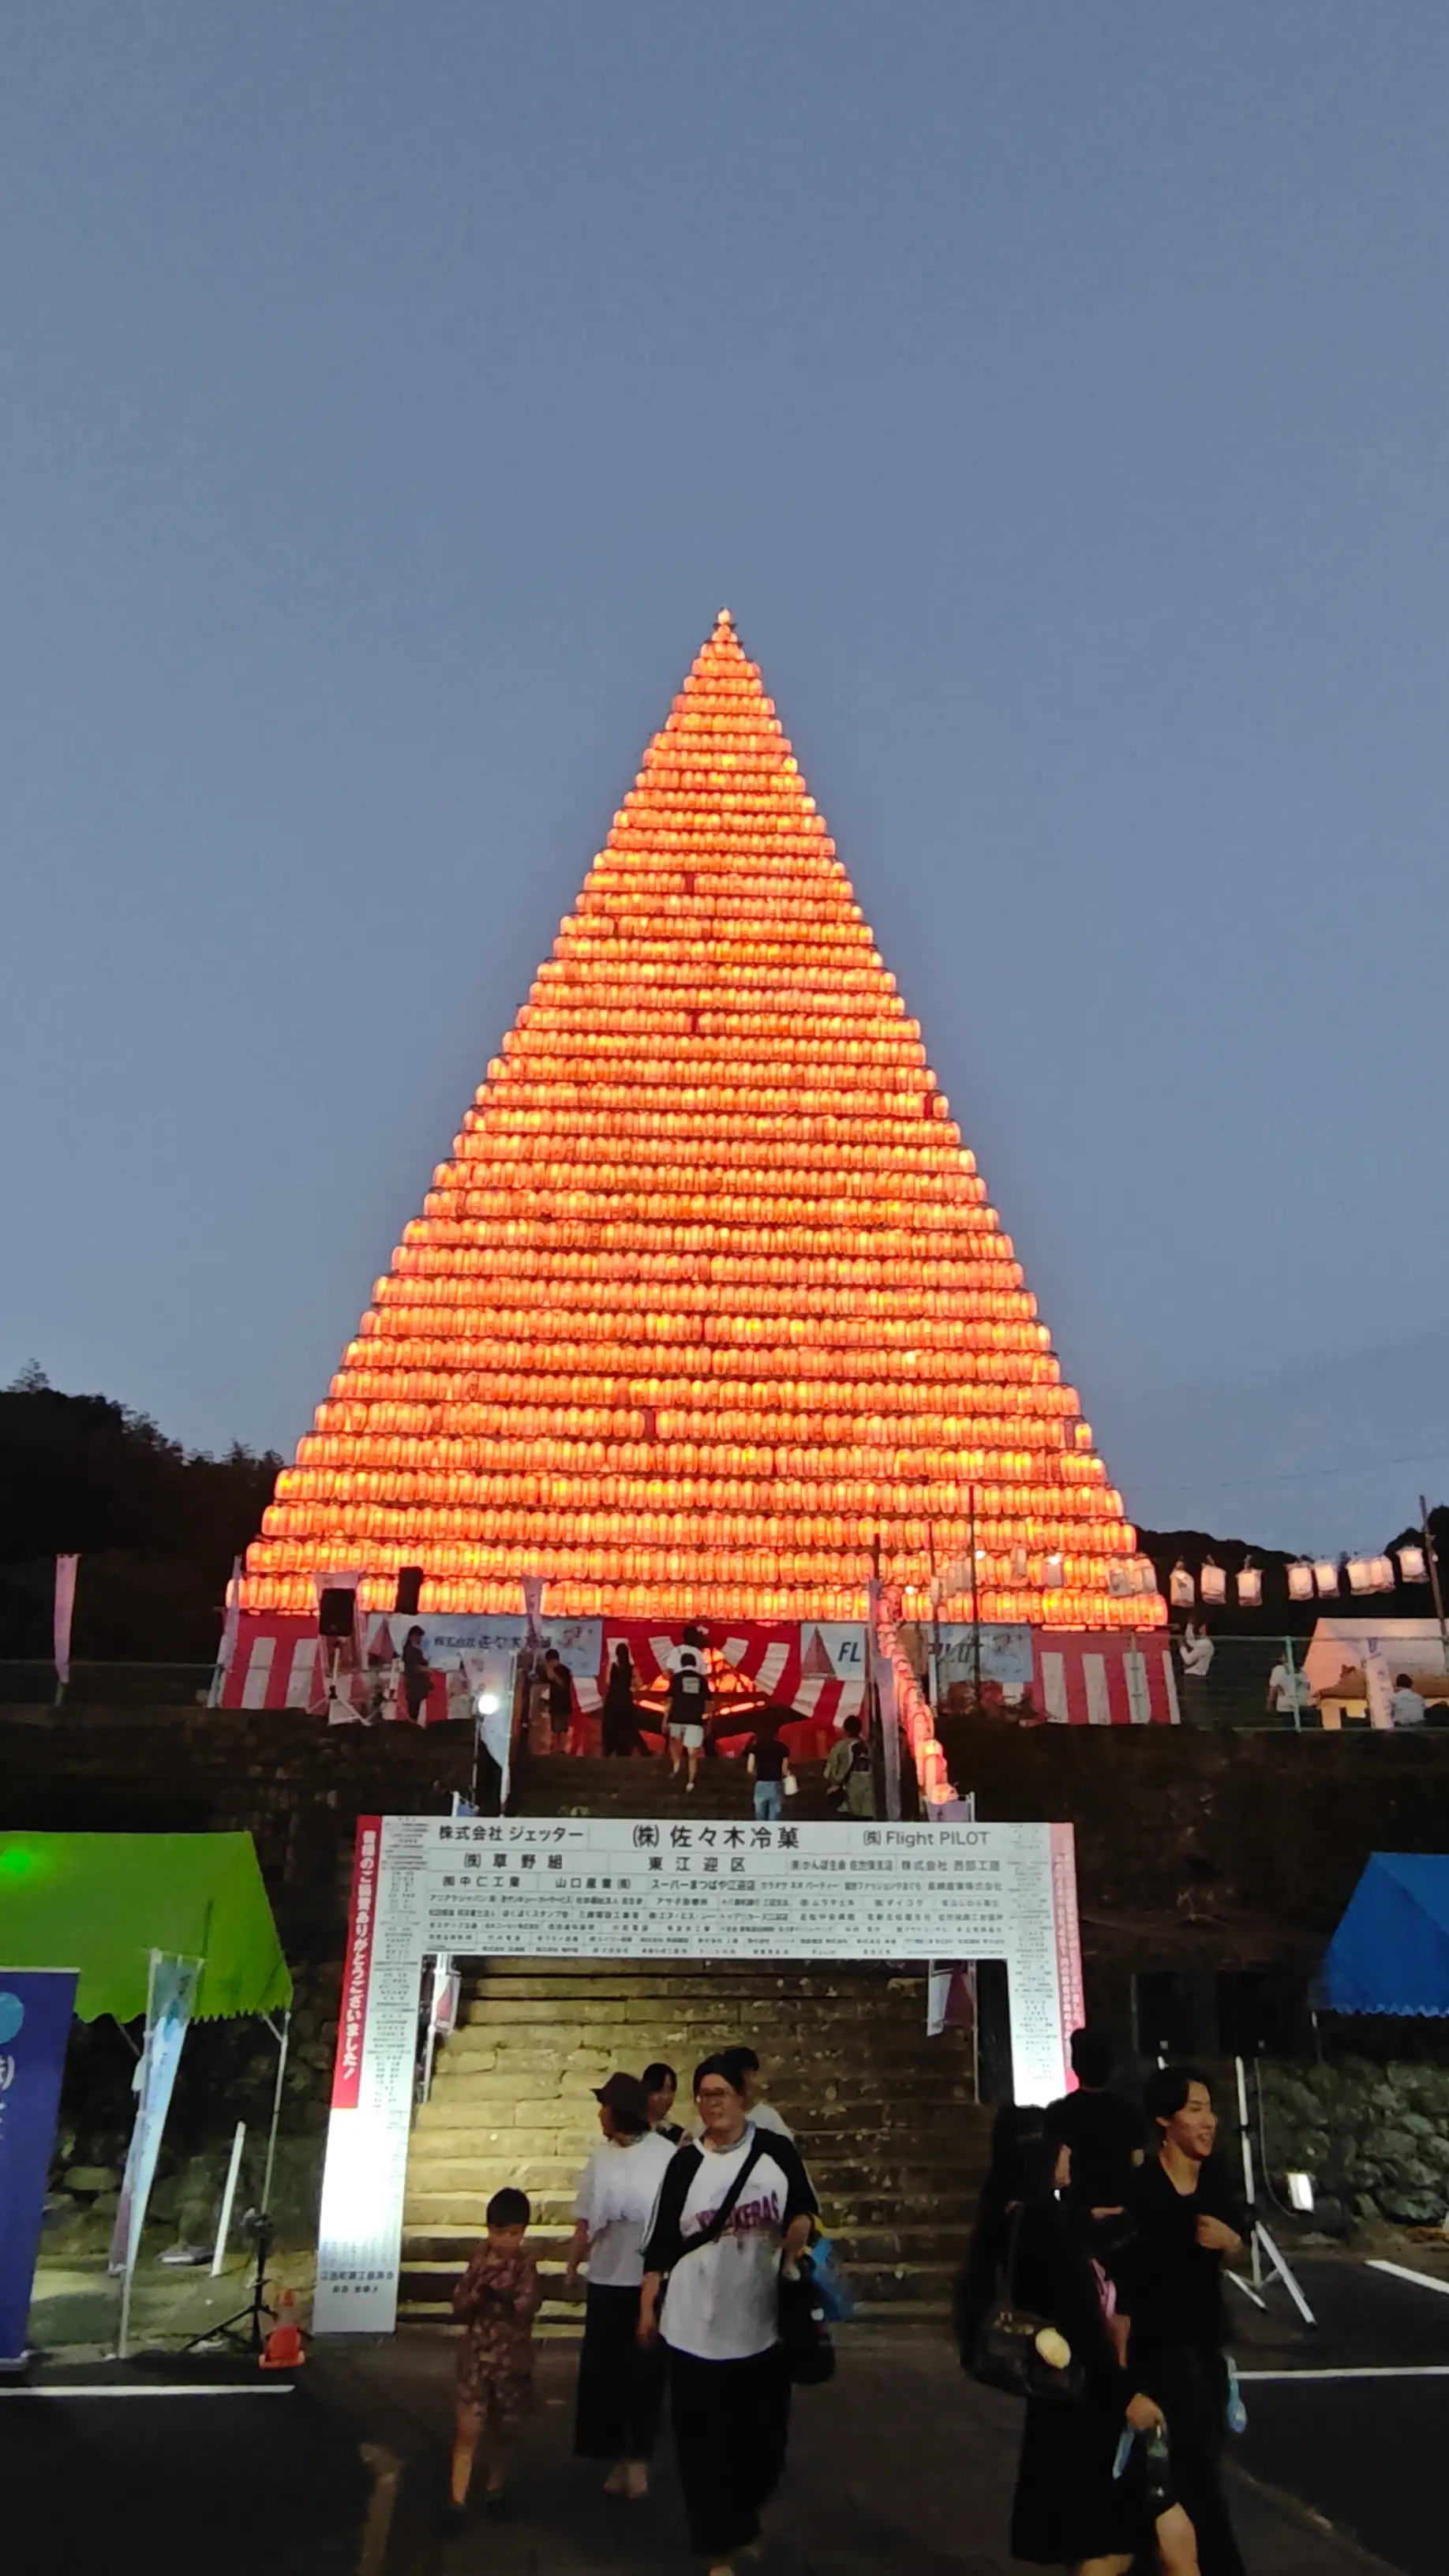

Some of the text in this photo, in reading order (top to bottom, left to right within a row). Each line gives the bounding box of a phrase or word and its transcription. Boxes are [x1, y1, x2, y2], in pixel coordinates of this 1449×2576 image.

[439, 1825, 583, 1842] 株式会社 ジェッター
[886, 1830, 934, 1848] Flight
[940, 1831, 990, 1846] PILOT
